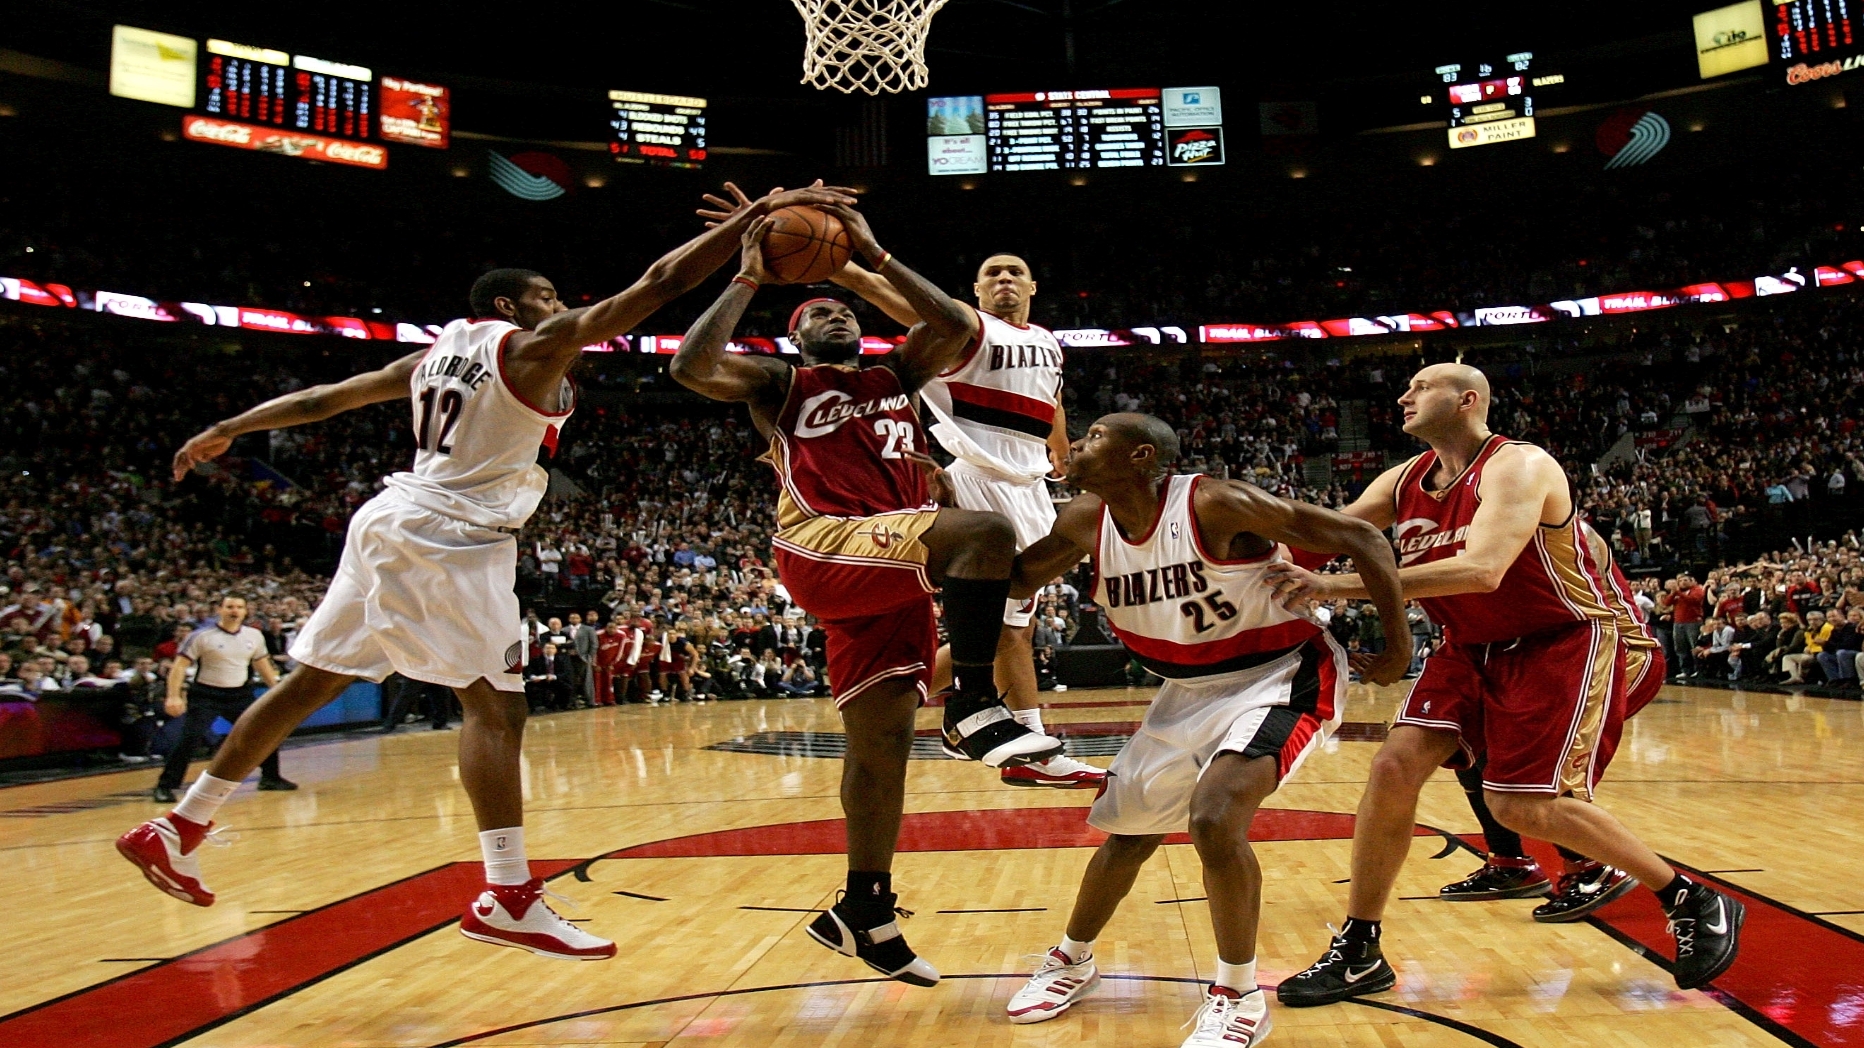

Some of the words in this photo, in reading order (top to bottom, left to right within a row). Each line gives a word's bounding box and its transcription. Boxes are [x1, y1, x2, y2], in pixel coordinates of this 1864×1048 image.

[1515, 60, 1529, 71] 82
[1787, 60, 1842, 85] Coors
[1443, 72, 1457, 82] 83
[1483, 121, 1526, 132] MILLER
[635, 133, 682, 145] STEALS
[1488, 131, 1522, 141] PAINT
[1174, 140, 1217, 158] Pizza
[1182, 148, 1212, 161] Hut
[1604, 297, 1647, 309] TRAIL
[1209, 328, 1250, 338] TRAIL
[421, 355, 493, 391] ALDRDGE
[419, 385, 463, 455] 12
[794, 390, 909, 438] CLEVELAND
[874, 418, 915, 460] 23
[1104, 560, 1208, 608] BLAZERS
[1180, 590, 1237, 634] 25
